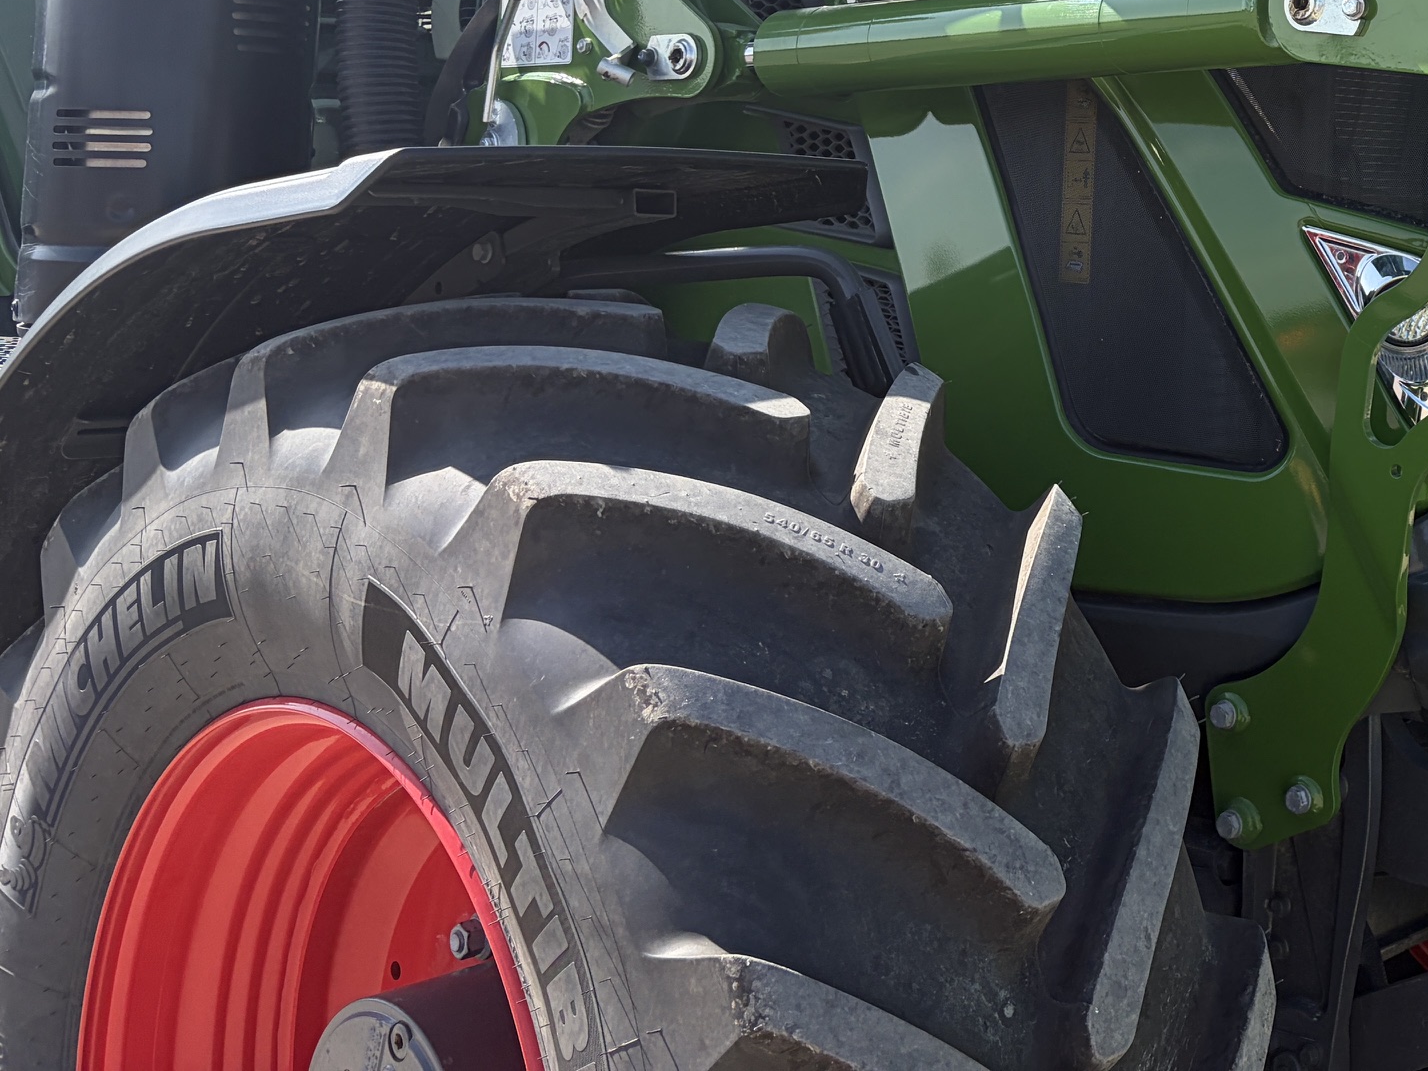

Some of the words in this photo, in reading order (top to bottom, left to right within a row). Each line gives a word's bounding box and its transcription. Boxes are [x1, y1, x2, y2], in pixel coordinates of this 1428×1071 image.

[763, 512, 836, 549] 540/65
[839, 542, 854, 559] R
[25, 538, 219, 819] MICHELIN
[397, 629, 596, 1071] MULTIB
